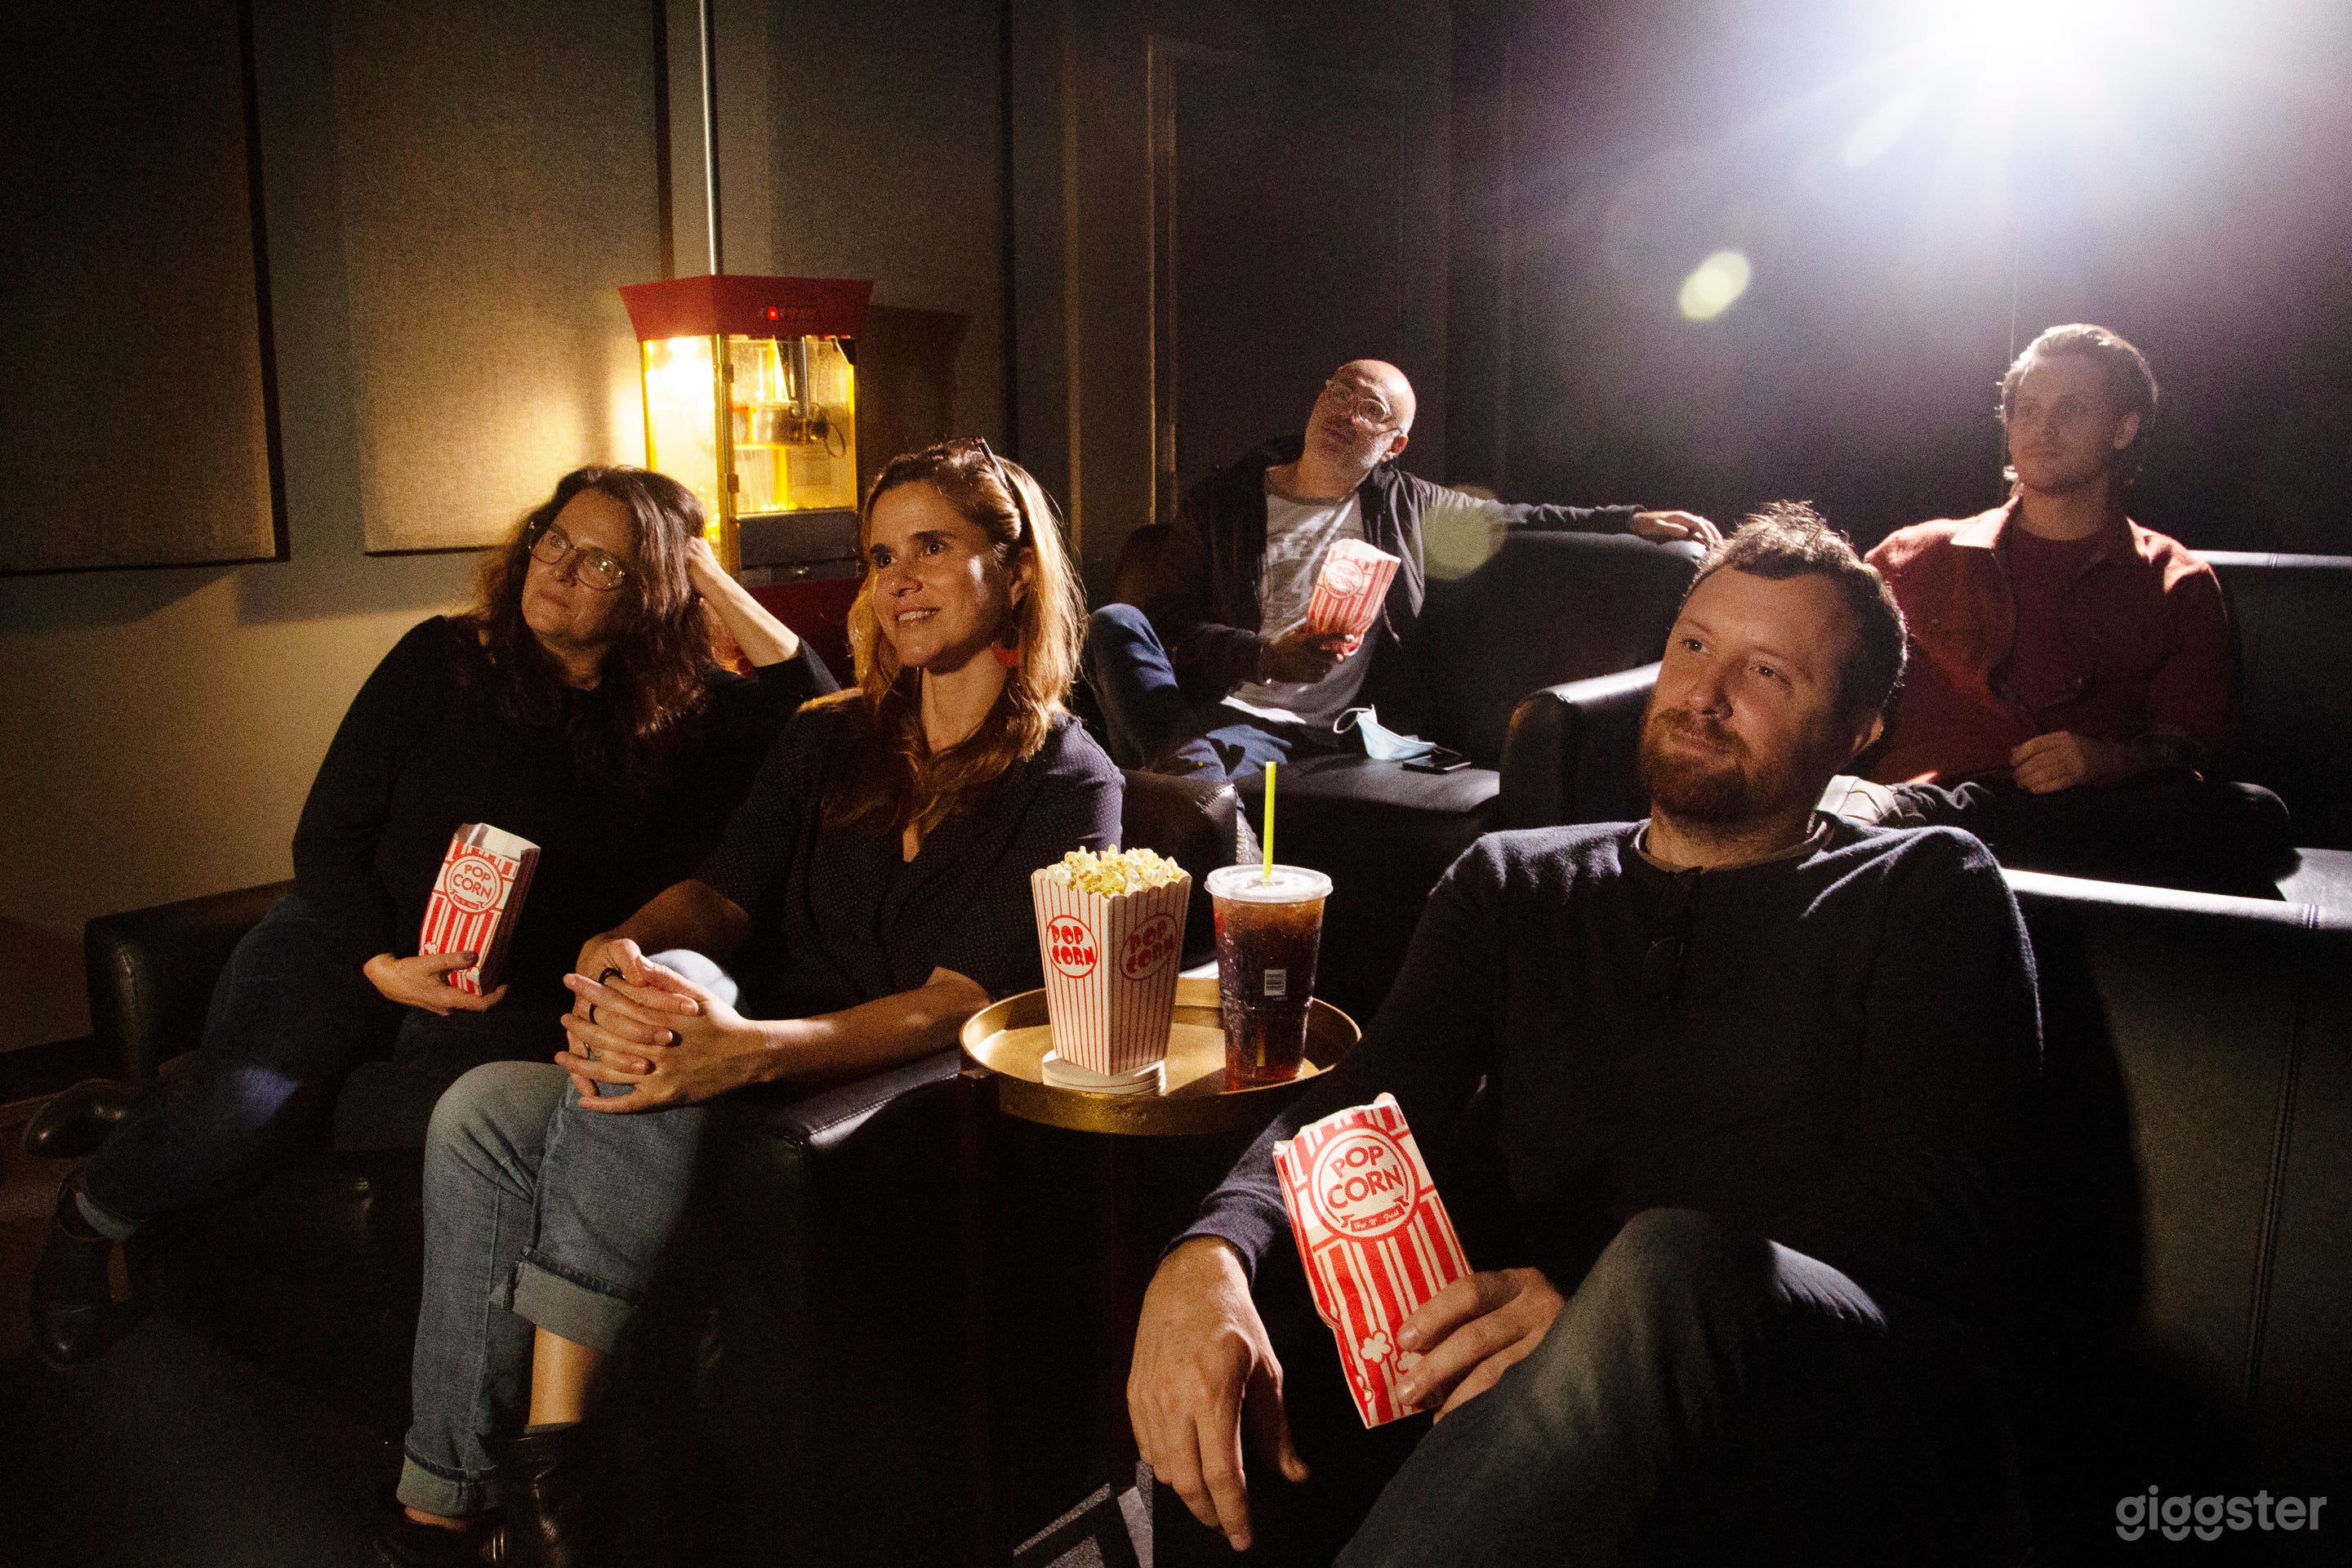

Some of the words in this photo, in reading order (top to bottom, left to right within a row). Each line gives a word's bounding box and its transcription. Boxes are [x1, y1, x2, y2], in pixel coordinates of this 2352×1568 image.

[453, 873, 492, 899] CORN
[465, 864, 491, 882] POP
[1051, 924, 1084, 945] POP
[1129, 920, 1167, 954] POP
[1052, 945, 1095, 966] CORN
[1126, 933, 1176, 973] CORN
[1330, 1145, 1383, 1178] POP
[1327, 1164, 1403, 1209] CORN
